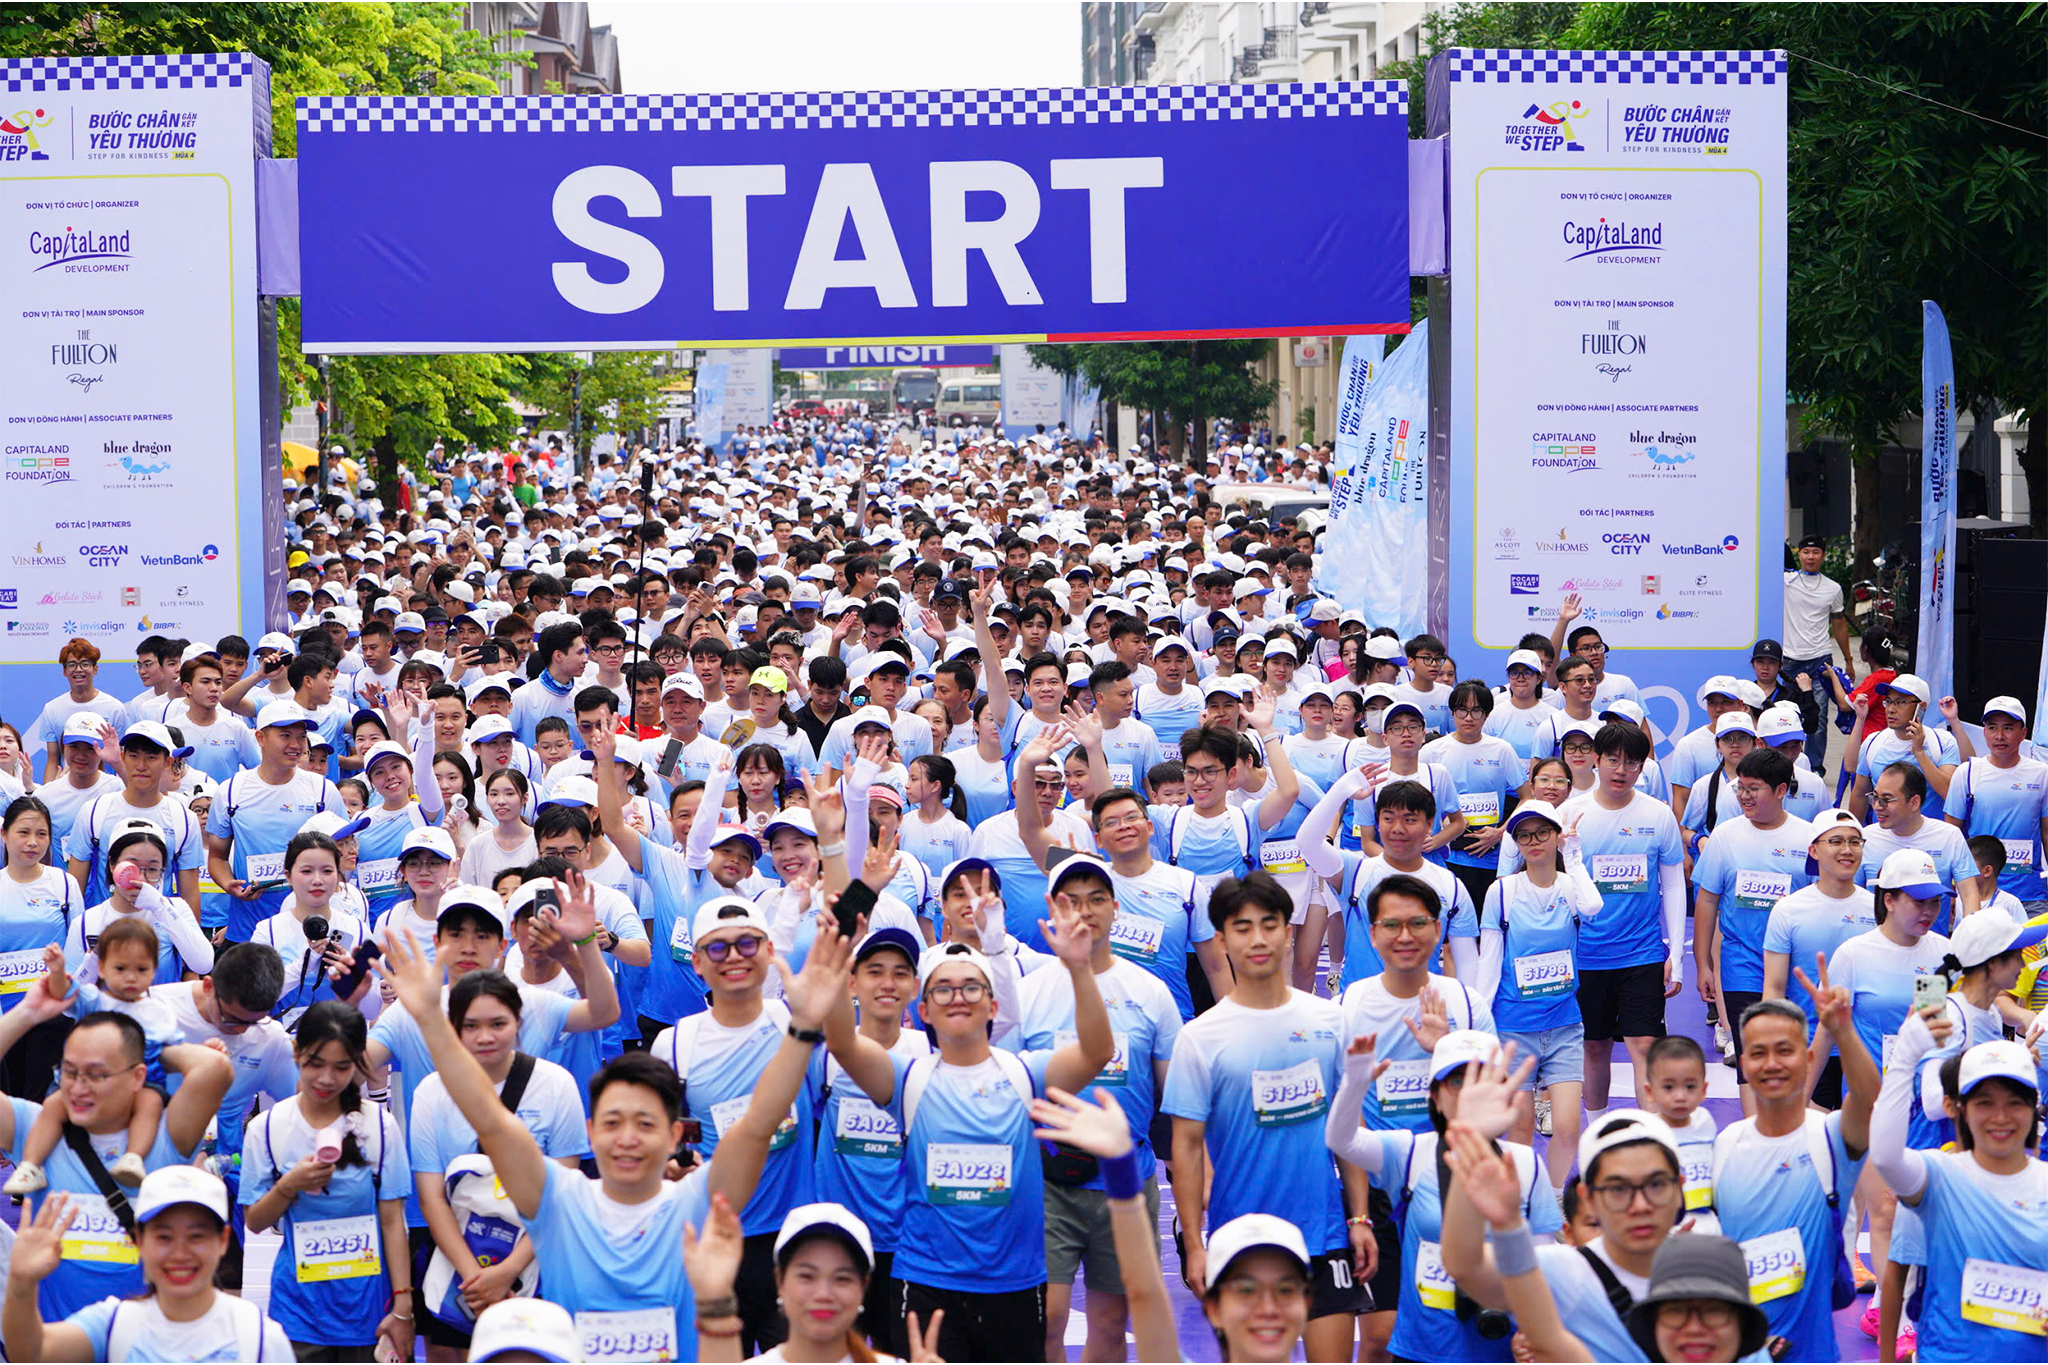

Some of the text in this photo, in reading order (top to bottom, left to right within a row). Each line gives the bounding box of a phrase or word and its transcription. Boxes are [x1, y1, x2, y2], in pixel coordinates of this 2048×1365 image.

[89, 110, 180, 129] BƯỚC CHÂN
[1624, 106, 1714, 123] BƯỚC CHÂN
[1505, 125, 1558, 135] TOGETHER
[1624, 124, 1729, 143] YÊU THƯƠNG
[89, 130, 197, 149] YÊU THƯƠNG
[1505, 135, 1564, 151] WE STEP
[129, 152, 169, 160] KINDNESS
[1628, 193, 1672, 201] ORGANIZER
[95, 200, 140, 209] ORGANIZER
[552, 156, 1164, 314] START
[1563, 217, 1662, 250] CapitaLand
[30, 226, 130, 260] CapitaLand
[1597, 256, 1661, 264] DEVELOPMENT
[65, 264, 130, 273] DEVELOPMENT
[107, 308, 145, 316] SPONSOR
[1607, 320, 1621, 331] THE
[77, 329, 91, 341] THE
[1582, 334, 1646, 355] FULLTON
[52, 343, 117, 365] FULLTON
[826, 345, 945, 363] FINISH
[1595, 363, 1632, 383] Regal
[66, 373, 103, 393] Regal
[1615, 404, 1659, 412] ASSOCIATE
[88, 414, 132, 422] ASSOCIATE
[133, 413, 173, 421] PARTNERS
[1532, 433, 1596, 442] CAPITALAND
[1629, 430, 1697, 449] blue dragon
[5, 444, 70, 455] CAPITALAND
[103, 441, 172, 459] blue dragon
[1379, 416, 1397, 498] CAPITALAND
[1532, 456, 1596, 467] FOUNDATION
[1353, 432, 1378, 504] blue dragon
[5, 469, 70, 481] FOUNDATION
[1336, 477, 1352, 510] STEP
[1615, 509, 1655, 517] PARTNERS
[92, 520, 131, 528] PARTNERS
[1602, 533, 1650, 544] OCEAN
[79, 545, 128, 556] OCEAN
[1535, 542, 1589, 552] VINHOMES
[1611, 545, 1642, 555] CITY
[1662, 544, 1724, 555] VietinBank
[11, 555, 66, 565] VINHOMES
[89, 557, 122, 567] CITY
[140, 549, 204, 566] VietinBank
[1600, 608, 1644, 620] invisalign
[80, 620, 125, 631] invisalign
[1460, 801, 1497, 813] 2A300
[1262, 848, 1300, 861] 2A369
[254, 863, 285, 877] 5179
[1600, 864, 1641, 877] 5B011
[1612, 883, 1629, 891] 5KM
[1742, 880, 1786, 896] 5B012
[1753, 900, 1770, 908] 5KM
[0, 960, 46, 977] 2A086
[1524, 963, 1567, 981] 51796
[1384, 1074, 1431, 1092] 5228
[1262, 1077, 1318, 1103] 51349
[845, 1114, 899, 1135] 5A02
[863, 1142, 888, 1154] 5KM
[934, 1160, 1006, 1180] 5A028
[955, 1190, 982, 1201] 5KM
[303, 1233, 370, 1257] 2A251
[1327, 1258, 1354, 1290] 10
[583, 1330, 670, 1356] 50488
